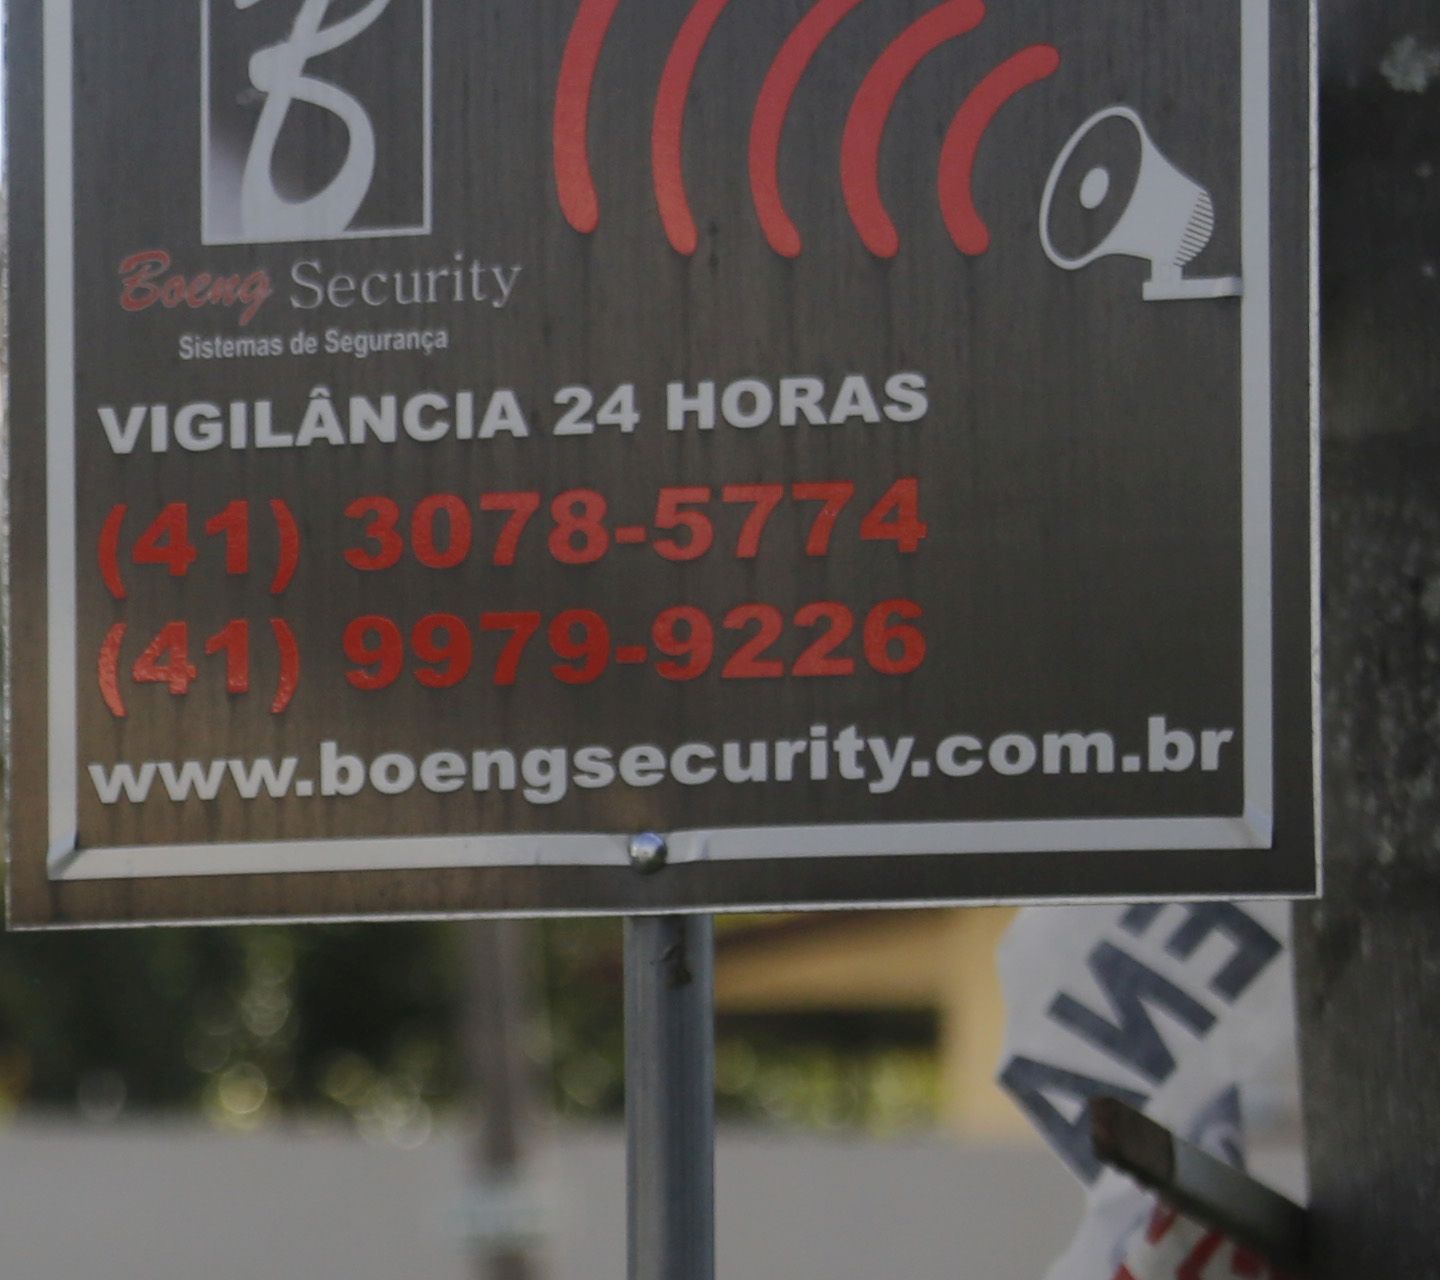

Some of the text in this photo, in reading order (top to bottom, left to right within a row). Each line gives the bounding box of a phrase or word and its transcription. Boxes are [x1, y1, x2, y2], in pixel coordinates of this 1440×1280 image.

[119, 249, 523, 326] Boeng Security
[179, 326, 450, 360] Sistemas de Segurança
[97, 372, 930, 456] VIGILÂNCIA 24 HORAS
[96, 477, 929, 599] (41) 3078-5774
[96, 599, 929, 718] (41) 9979-9226
[87, 717, 1236, 807] www.boengsecurity.com.br
